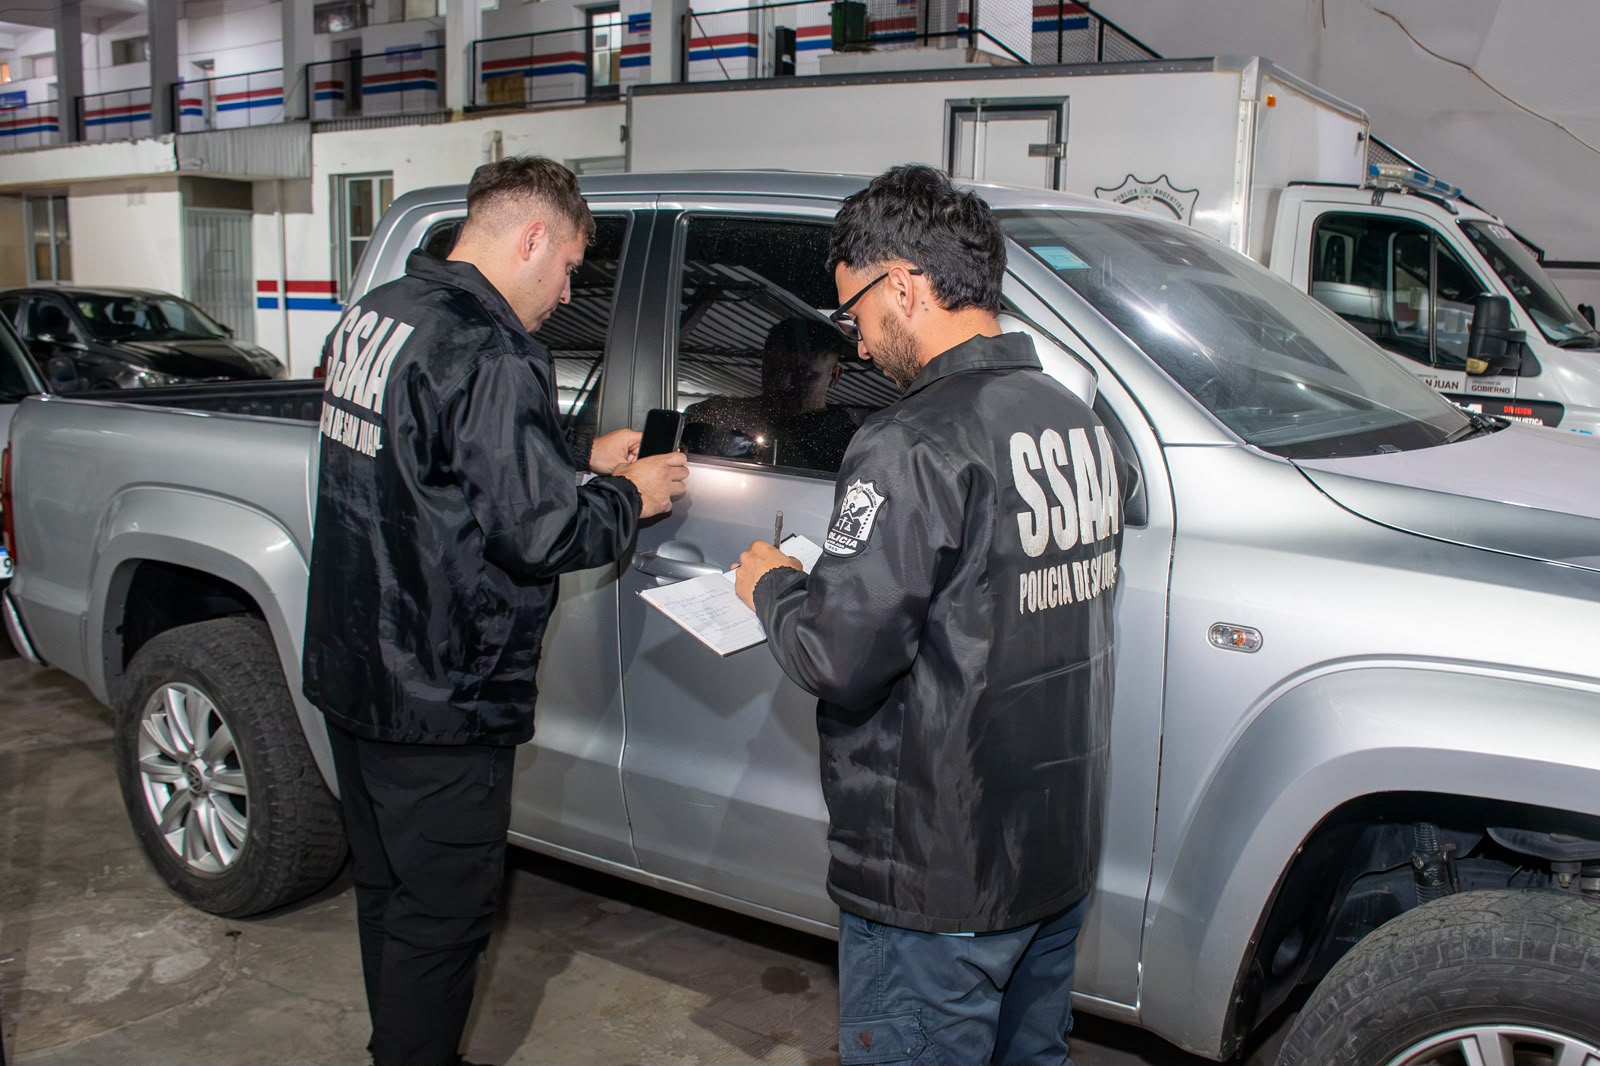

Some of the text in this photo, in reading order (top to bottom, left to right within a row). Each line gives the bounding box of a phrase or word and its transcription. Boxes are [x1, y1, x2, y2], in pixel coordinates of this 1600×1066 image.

[325, 305, 415, 415] SSAA
[1433, 379, 1459, 390] JUAN
[1471, 384, 1510, 394] GOBIERNO
[1009, 425, 1119, 558] SSAA
[1019, 564, 1073, 615] POLICIA
